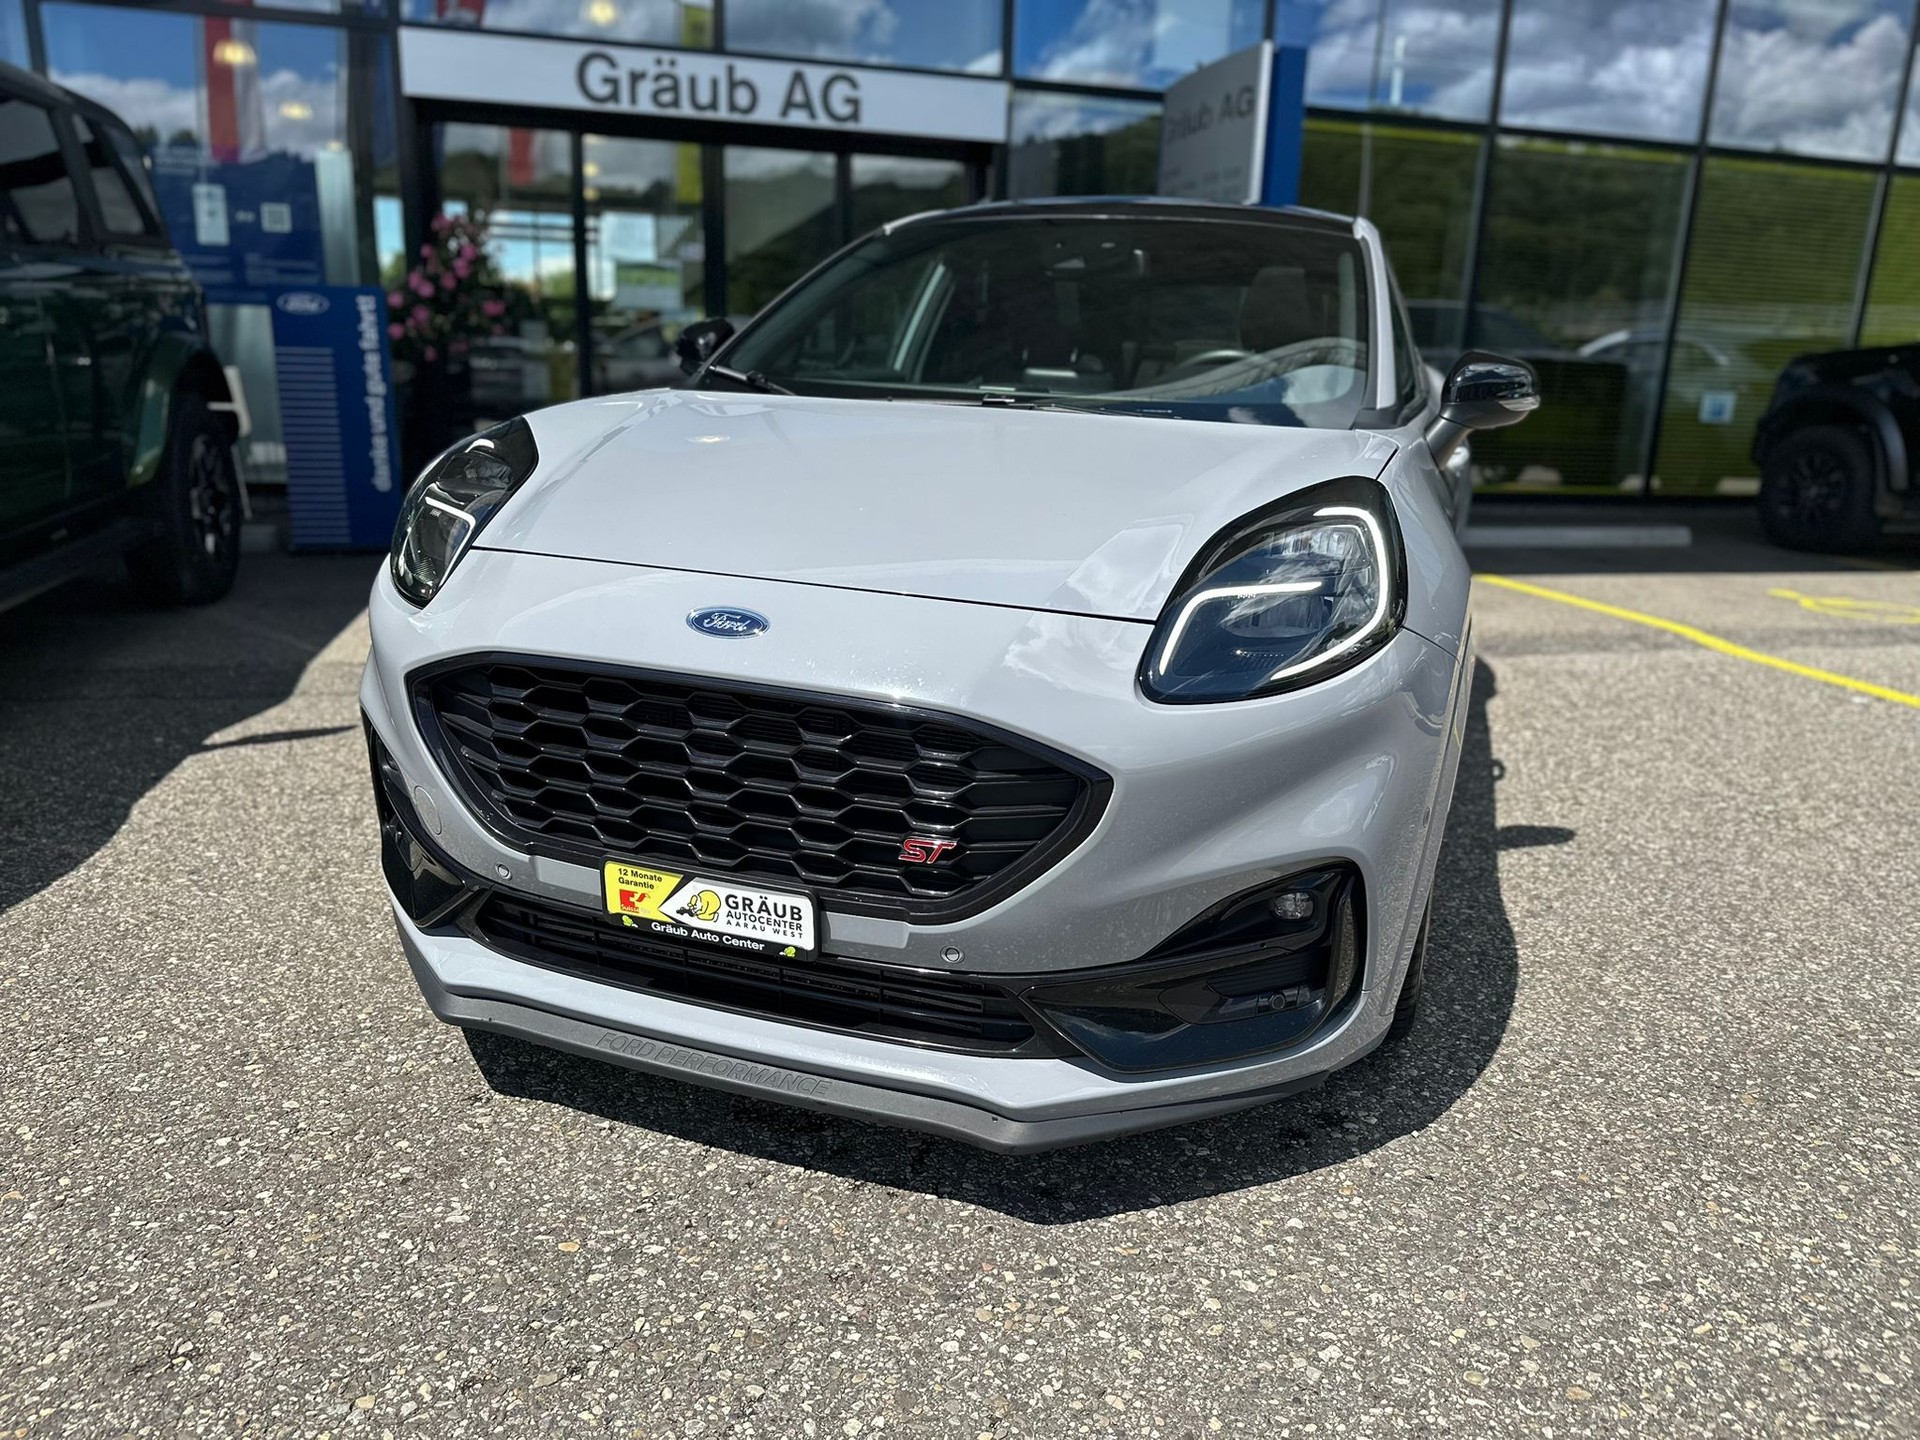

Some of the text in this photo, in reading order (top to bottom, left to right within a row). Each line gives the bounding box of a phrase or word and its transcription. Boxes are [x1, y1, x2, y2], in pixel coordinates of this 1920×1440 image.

[576, 51, 861, 123] Gräub AG
[703, 612, 751, 632] Ford
[898, 838, 957, 864] ST
[618, 868, 662, 882] 12 Monate
[618, 876, 655, 890] Garantie
[725, 894, 802, 921] GRÄUB
[726, 910, 803, 931] AUTOCENTER
[726, 920, 803, 939] AARAU WEST
[651, 921, 765, 951] Gräub Auto Center
[596, 1032, 833, 1096] FORD PERFORMANCE
